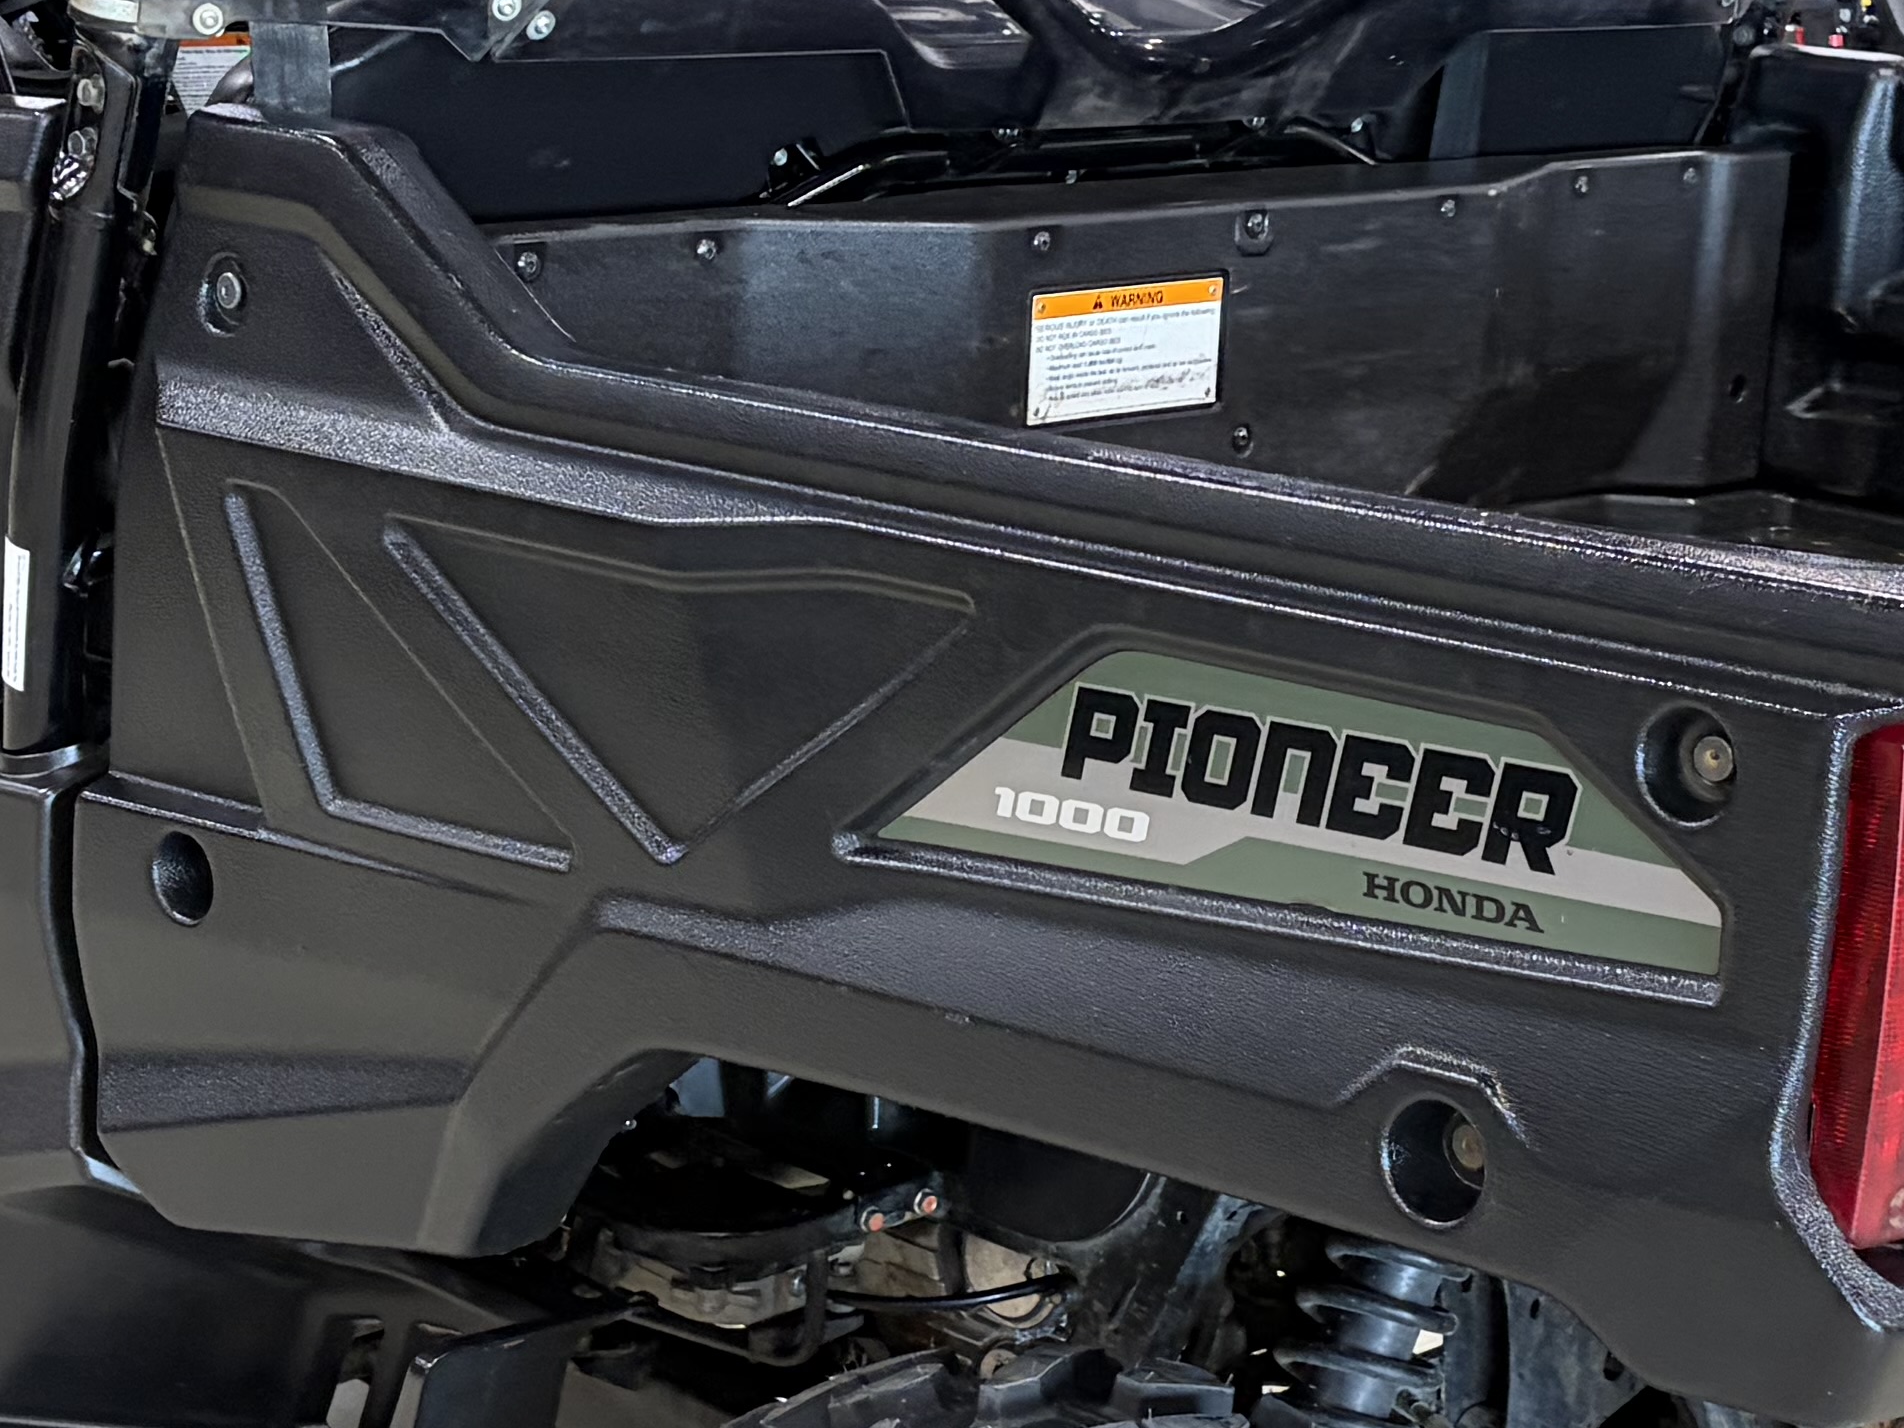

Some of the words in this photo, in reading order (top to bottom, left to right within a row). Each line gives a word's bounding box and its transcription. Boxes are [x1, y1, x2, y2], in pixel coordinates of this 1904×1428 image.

[1110, 290, 1164, 309] WARNING
[1060, 684, 1580, 876] PIONEER
[993, 785, 1152, 846] 1000
[1361, 871, 1545, 934] HONDA
